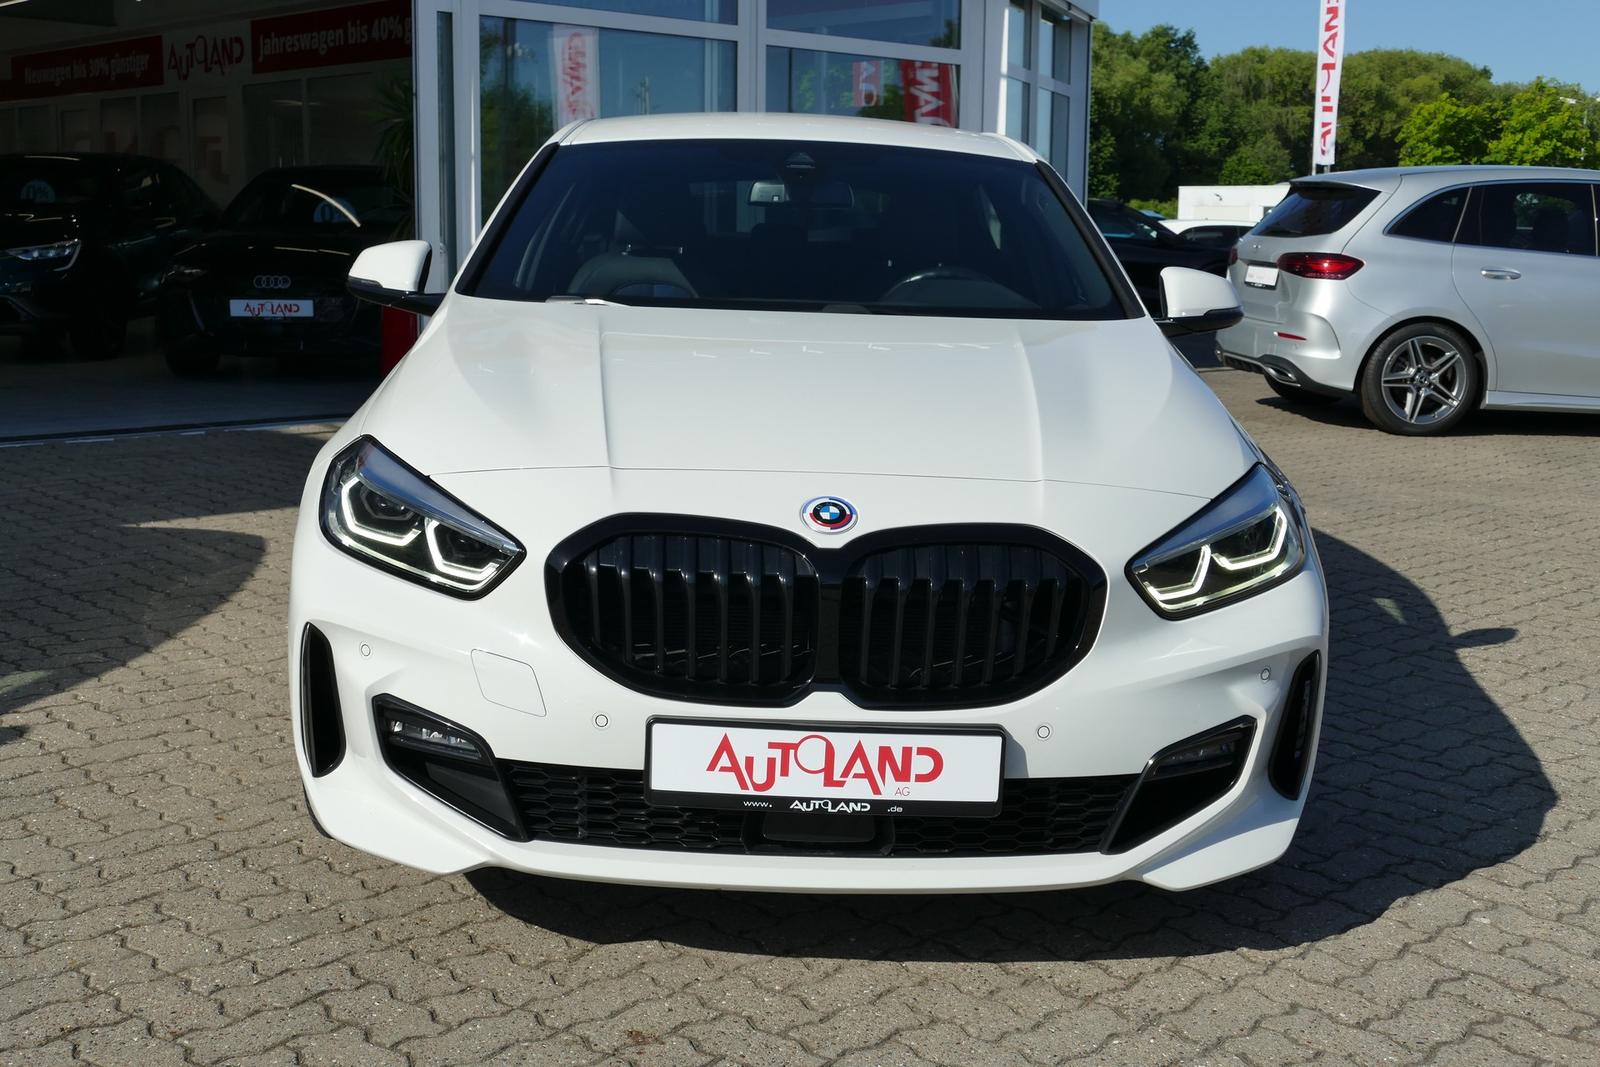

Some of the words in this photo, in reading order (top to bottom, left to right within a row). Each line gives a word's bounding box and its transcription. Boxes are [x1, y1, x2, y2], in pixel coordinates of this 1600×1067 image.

[168, 35, 244, 80] AUTOLAND
[258, 27, 345, 63] Jahreswagen
[347, 20, 369, 45] bis
[371, 15, 404, 42] 40%
[706, 732, 944, 796] AUTOLAND
[789, 799, 871, 813] AUTOLAND
[894, 787, 911, 797] AG
